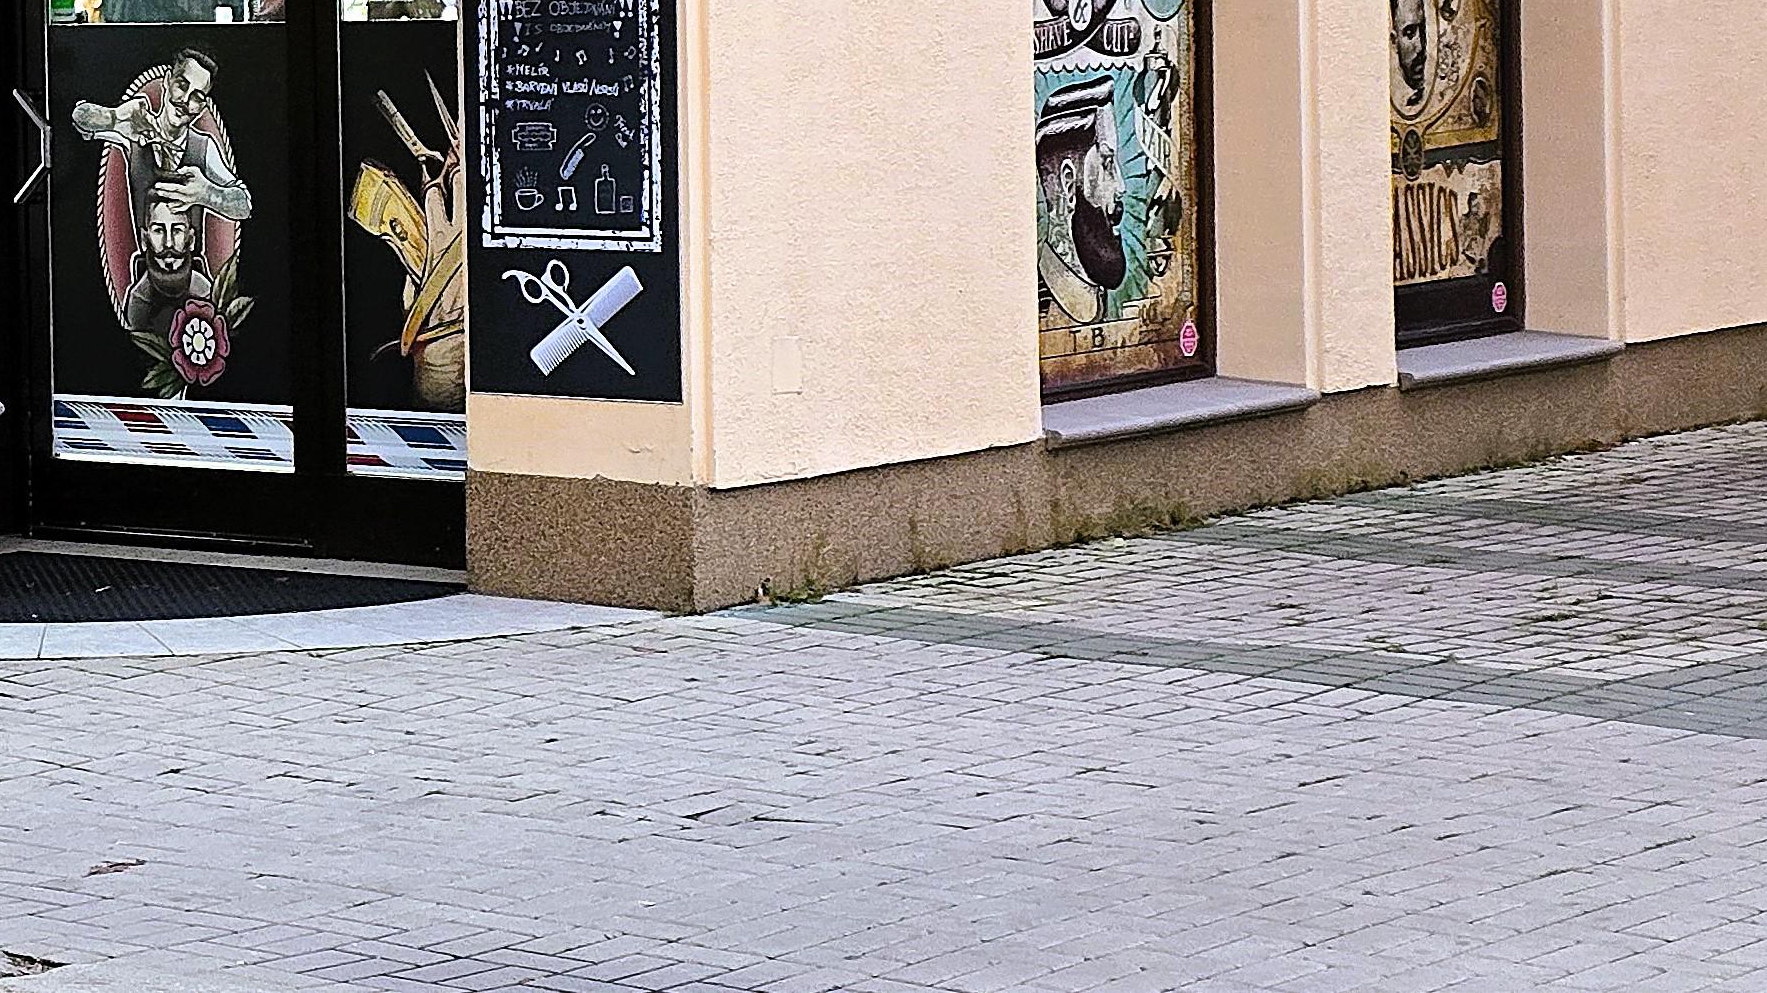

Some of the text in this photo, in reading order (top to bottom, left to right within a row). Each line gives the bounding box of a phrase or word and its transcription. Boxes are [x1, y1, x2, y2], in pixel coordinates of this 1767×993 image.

[1034, 19, 1073, 55] SHAVE
[1102, 20, 1130, 53] CUT
[1393, 182, 1460, 282] ASSICS
